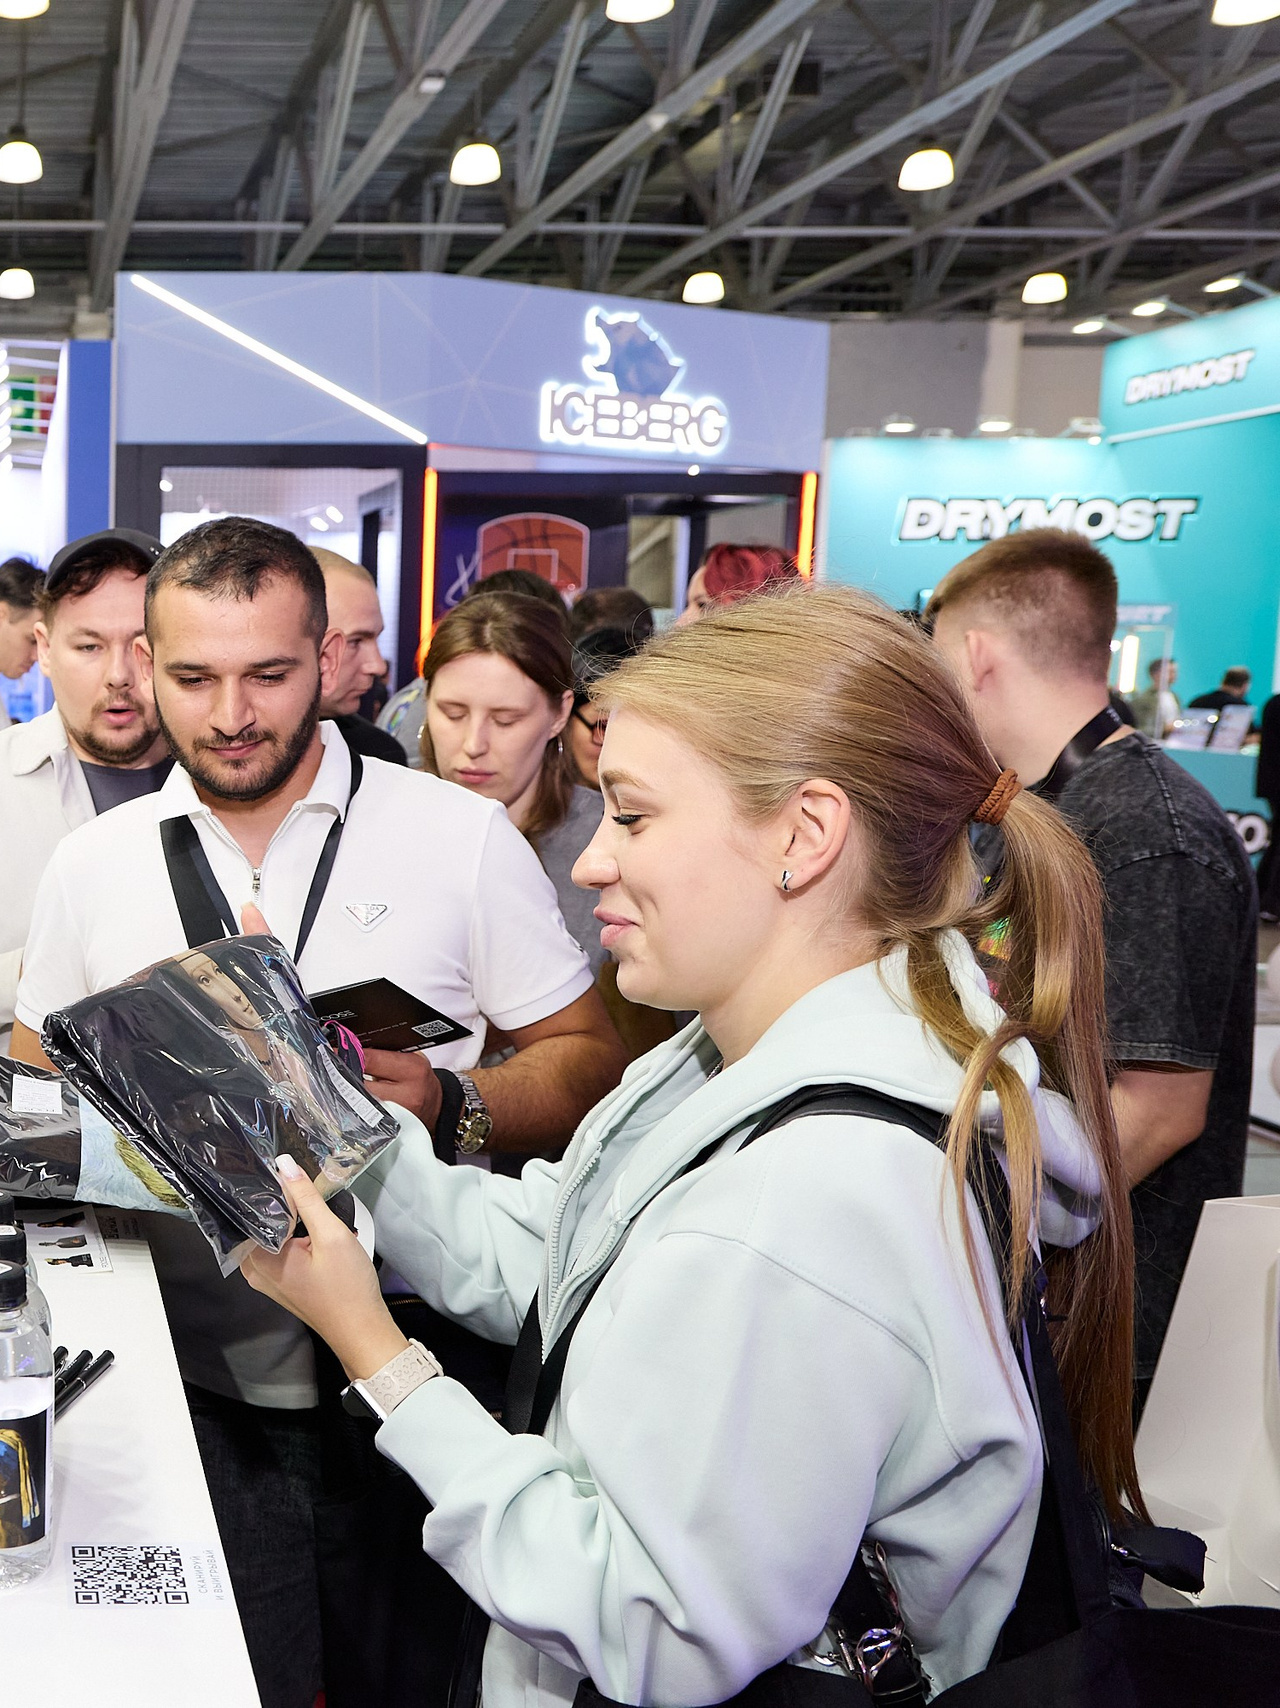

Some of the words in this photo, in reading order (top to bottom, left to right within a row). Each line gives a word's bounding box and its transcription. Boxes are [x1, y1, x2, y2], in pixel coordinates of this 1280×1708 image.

[1124, 348, 1256, 406] DRYMOST
[541, 383, 728, 455] ICEBERG
[898, 498, 1200, 542] DRYMOST
[192, 1554, 208, 1594] СКАНИРУЙ
[202, 1549, 223, 1594] ВЫИГРЫВАЙ
